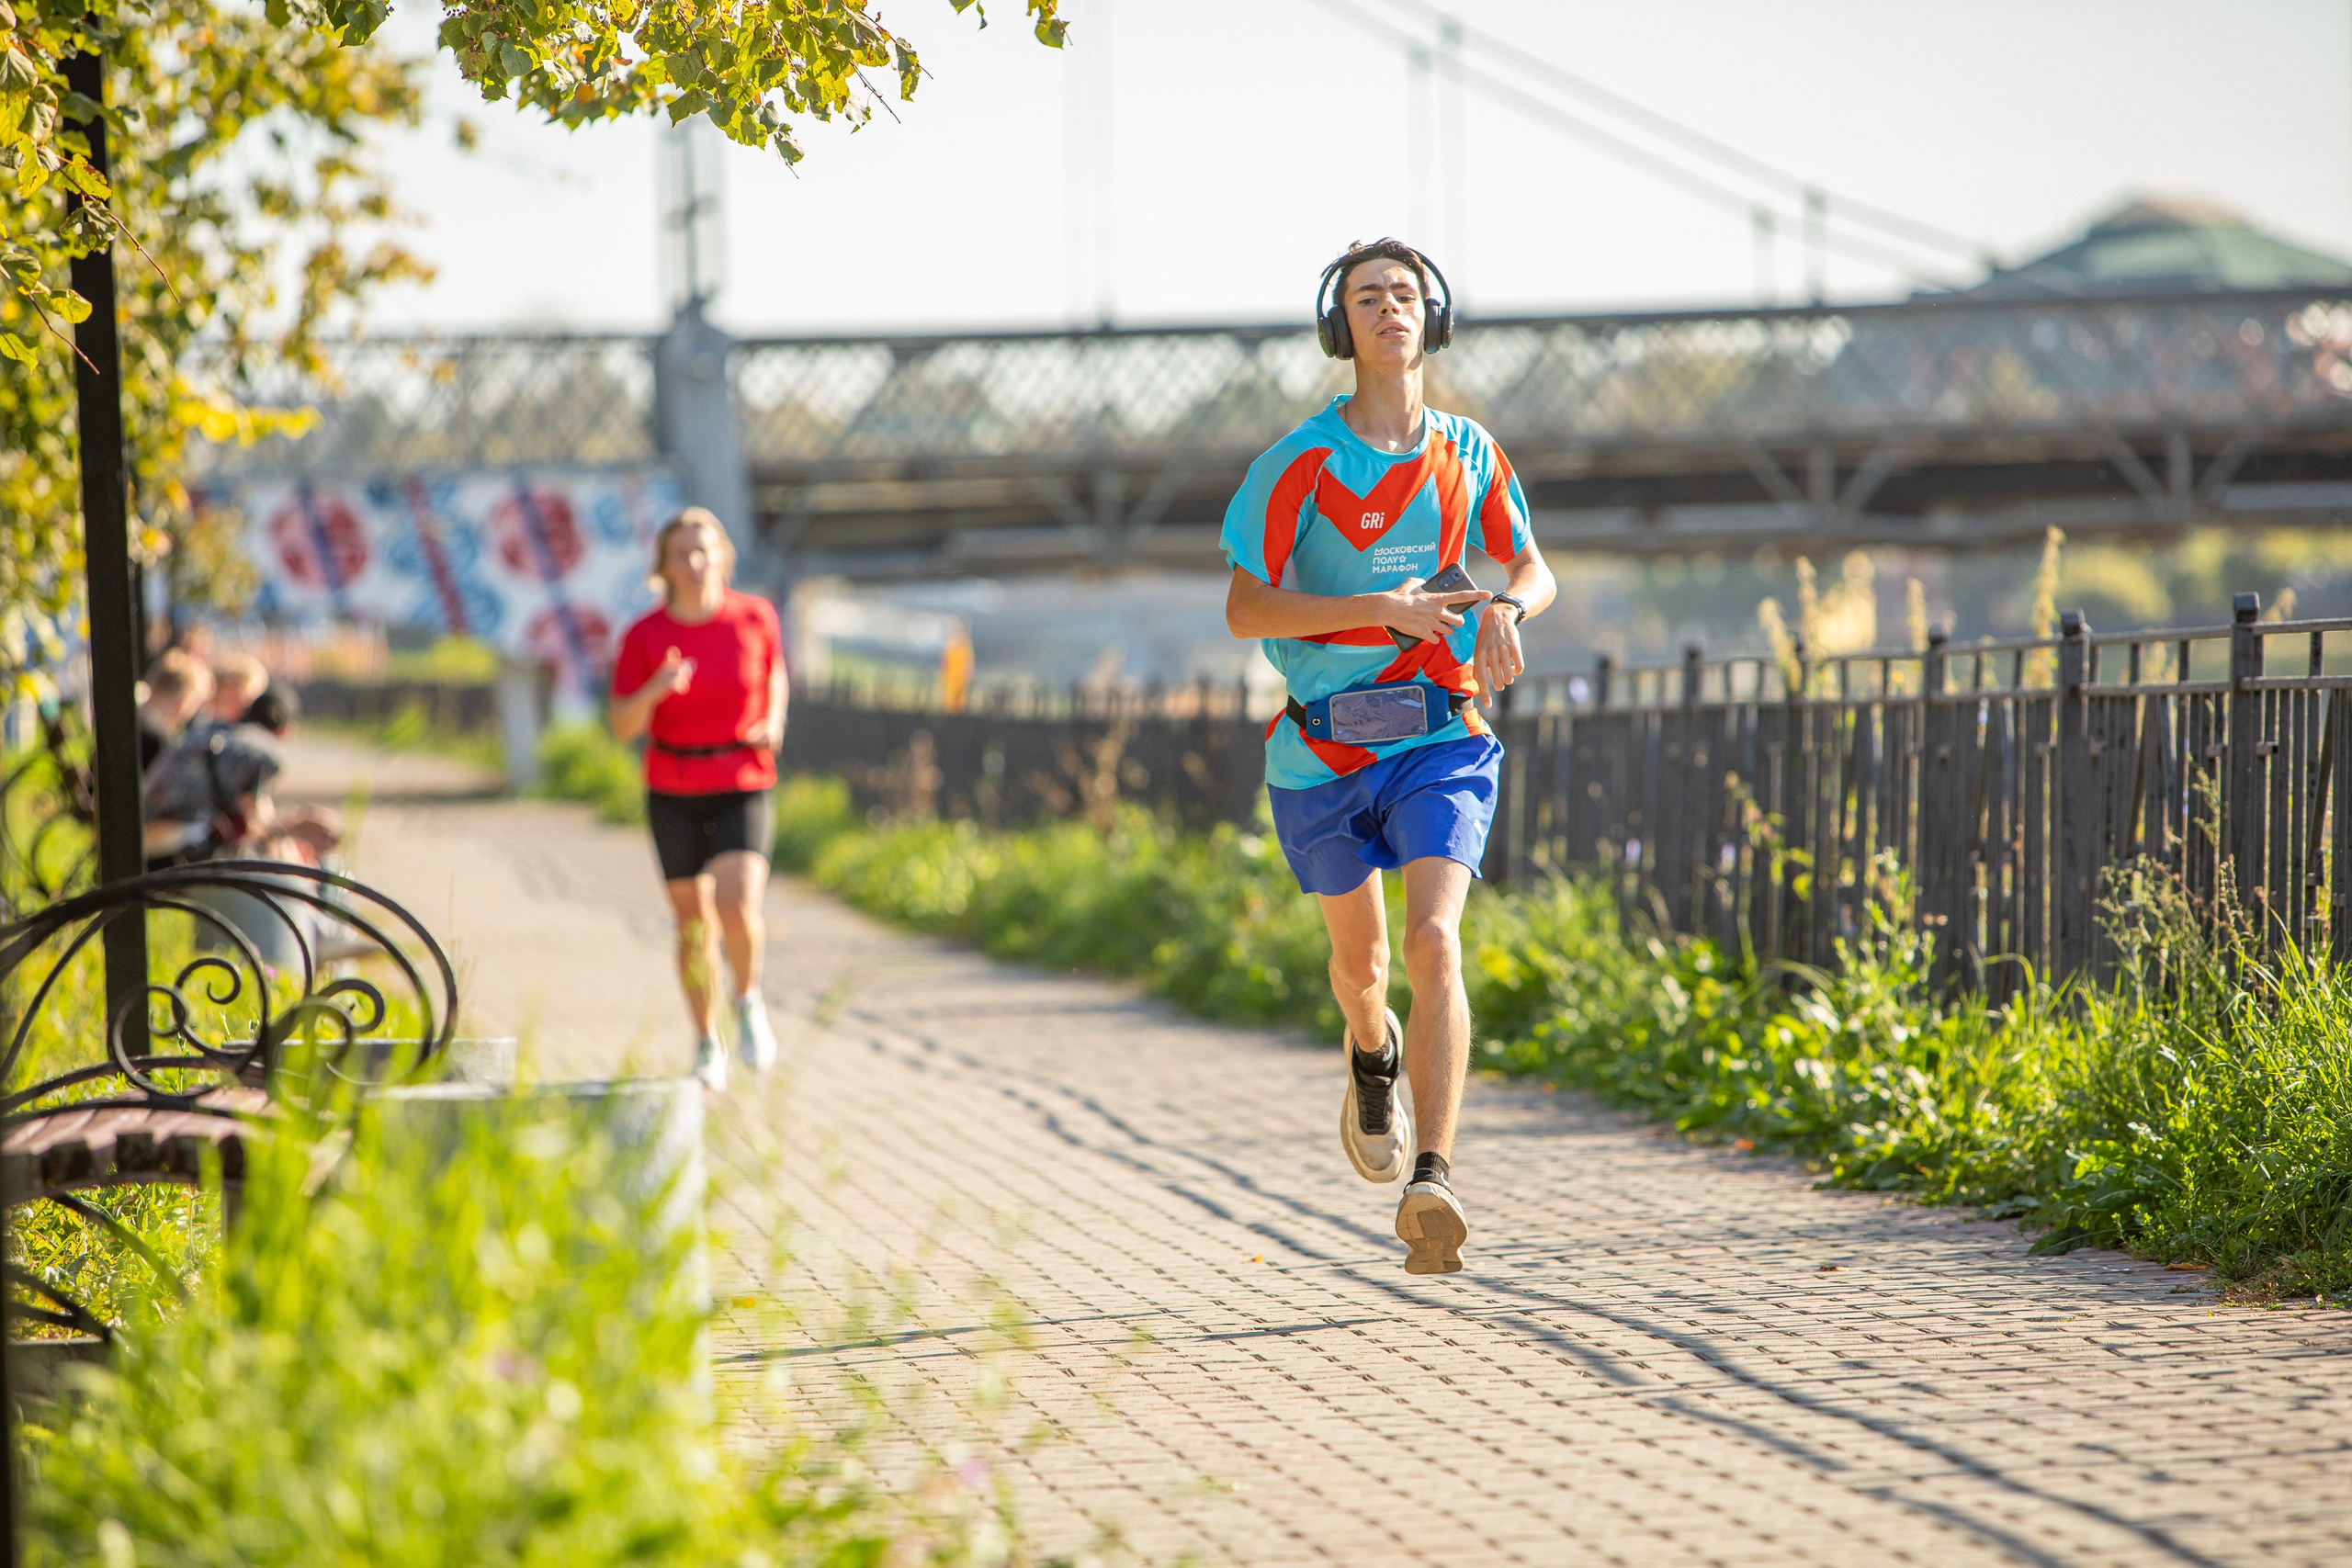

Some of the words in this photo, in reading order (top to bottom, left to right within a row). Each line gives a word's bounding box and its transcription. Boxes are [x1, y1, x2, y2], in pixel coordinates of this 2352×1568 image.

[1374, 542, 1436, 556] МОСКОВСКИЙ
[1373, 556, 1397, 565] ПОЛУ
[1372, 563, 1419, 574] МАРАФОН
